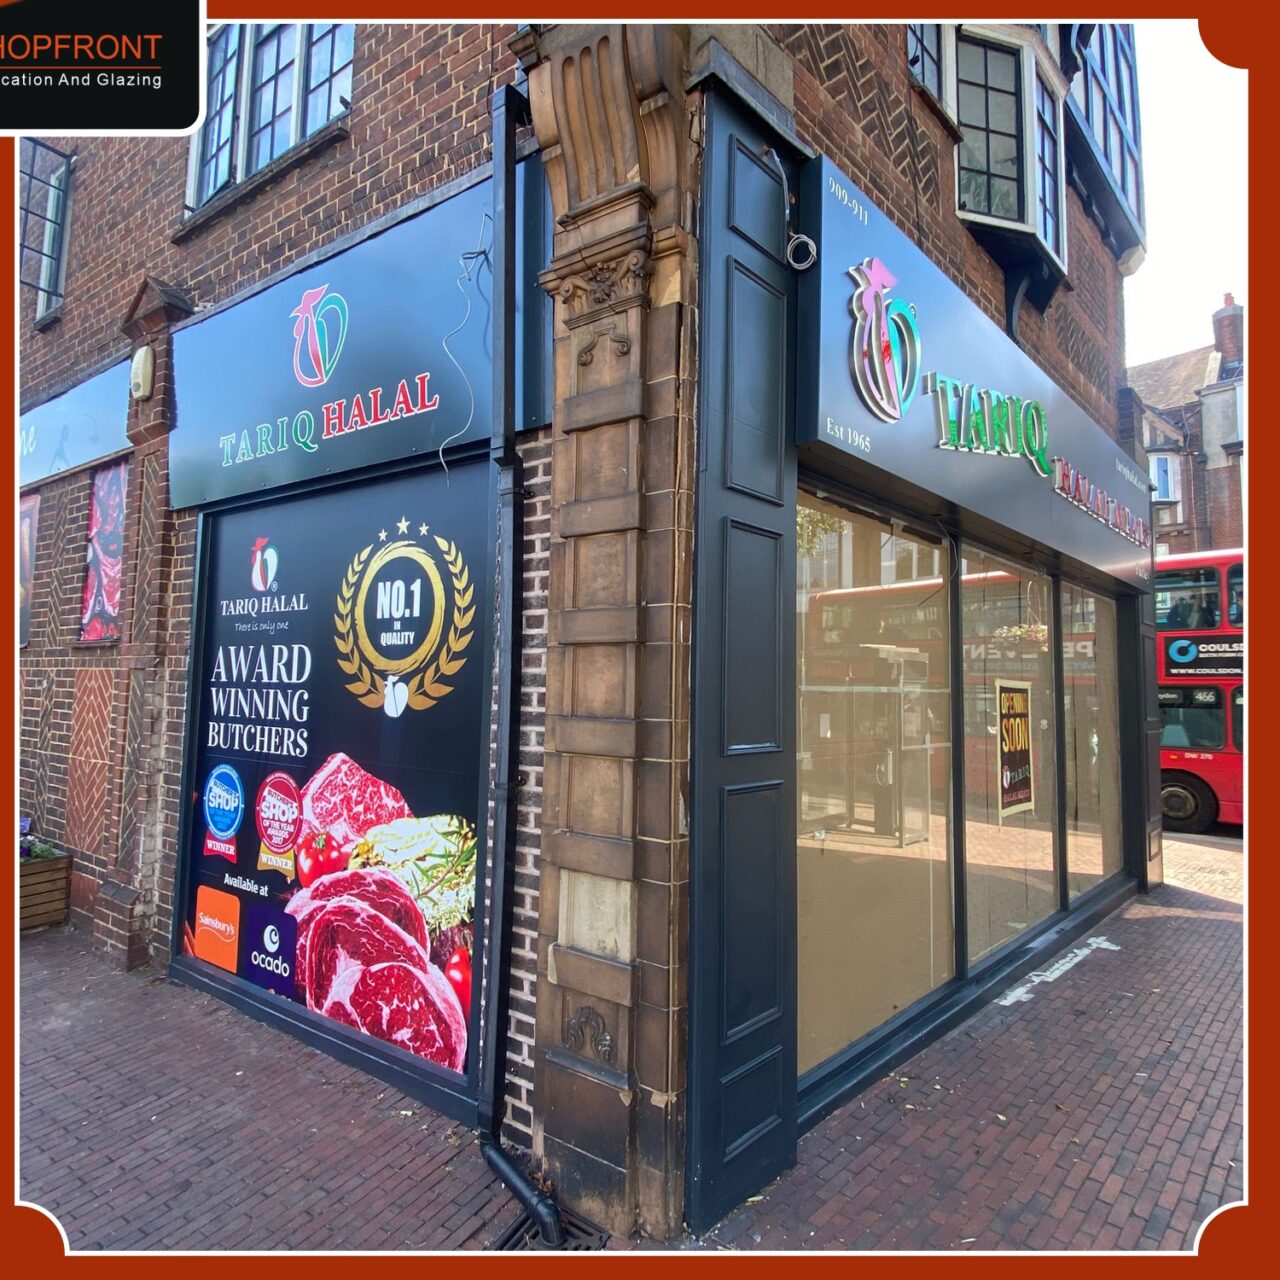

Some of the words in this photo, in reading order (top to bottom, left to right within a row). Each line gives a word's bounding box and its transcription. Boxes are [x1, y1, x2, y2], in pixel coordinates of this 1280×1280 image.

[827, 176, 870, 227] 909-911
[219, 410, 319, 467] TARIQ
[322, 372, 440, 439] HALAL
[927, 371, 1055, 477] TARIQ
[826, 417, 844, 437] Est
[846, 425, 872, 453] 1965
[220, 597, 259, 617] TARIQ
[261, 593, 309, 613] HALAL
[376, 578, 421, 620] NO.1
[234, 622, 251, 632] There
[251, 621, 259, 631] is
[259, 620, 276, 635] only
[276, 620, 289, 630] one
[380, 631, 415, 646] QUALITY
[394, 621, 401, 631] IN
[210, 644, 312, 684] AWARD
[210, 687, 310, 722] WINNING
[1195, 691, 1216, 702] 466
[207, 722, 309, 758] BUTCHERS
[1001, 717, 1029, 754] SOON
[208, 791, 239, 812] SHOP
[261, 801, 298, 823] SHOP
[207, 839, 235, 856] WINNER
[261, 853, 293, 871] WINNER
[223, 873, 257, 895] Available
[258, 884, 269, 897] at
[198, 911, 236, 937] Sainsbury's
[251, 951, 290, 978] ocado
